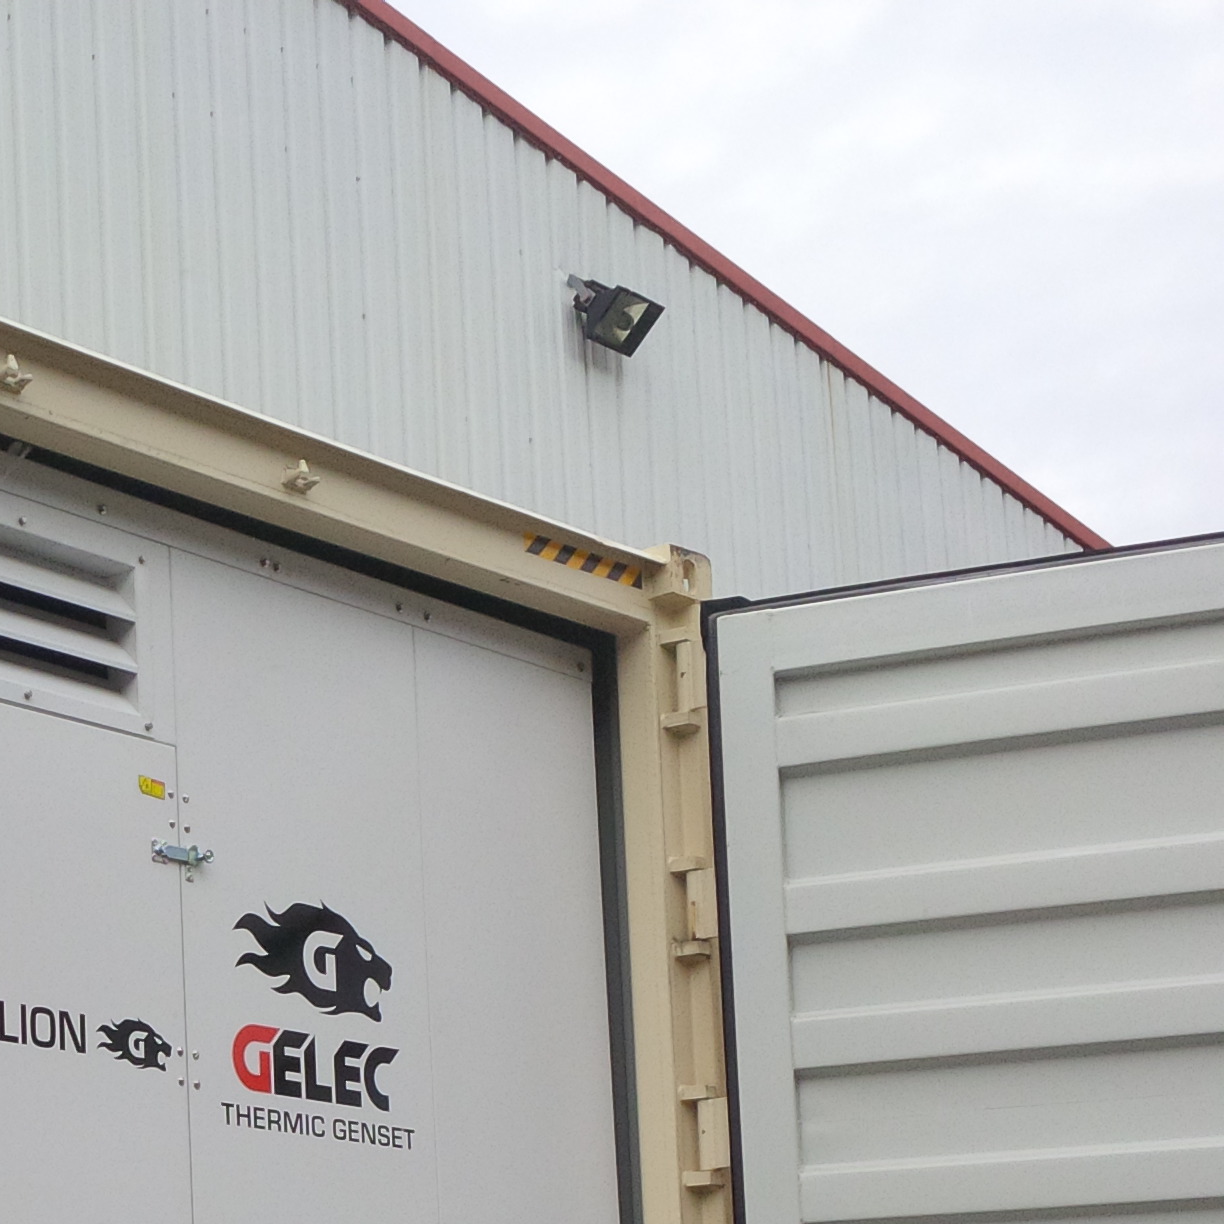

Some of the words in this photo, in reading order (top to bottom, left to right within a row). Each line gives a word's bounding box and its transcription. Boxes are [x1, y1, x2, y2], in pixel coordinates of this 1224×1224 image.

[303, 930, 344, 992] G
[232, 1024, 400, 1112] GELEC
[221, 1102, 326, 1138] THERMIC
[332, 1118, 415, 1150] GENSET
